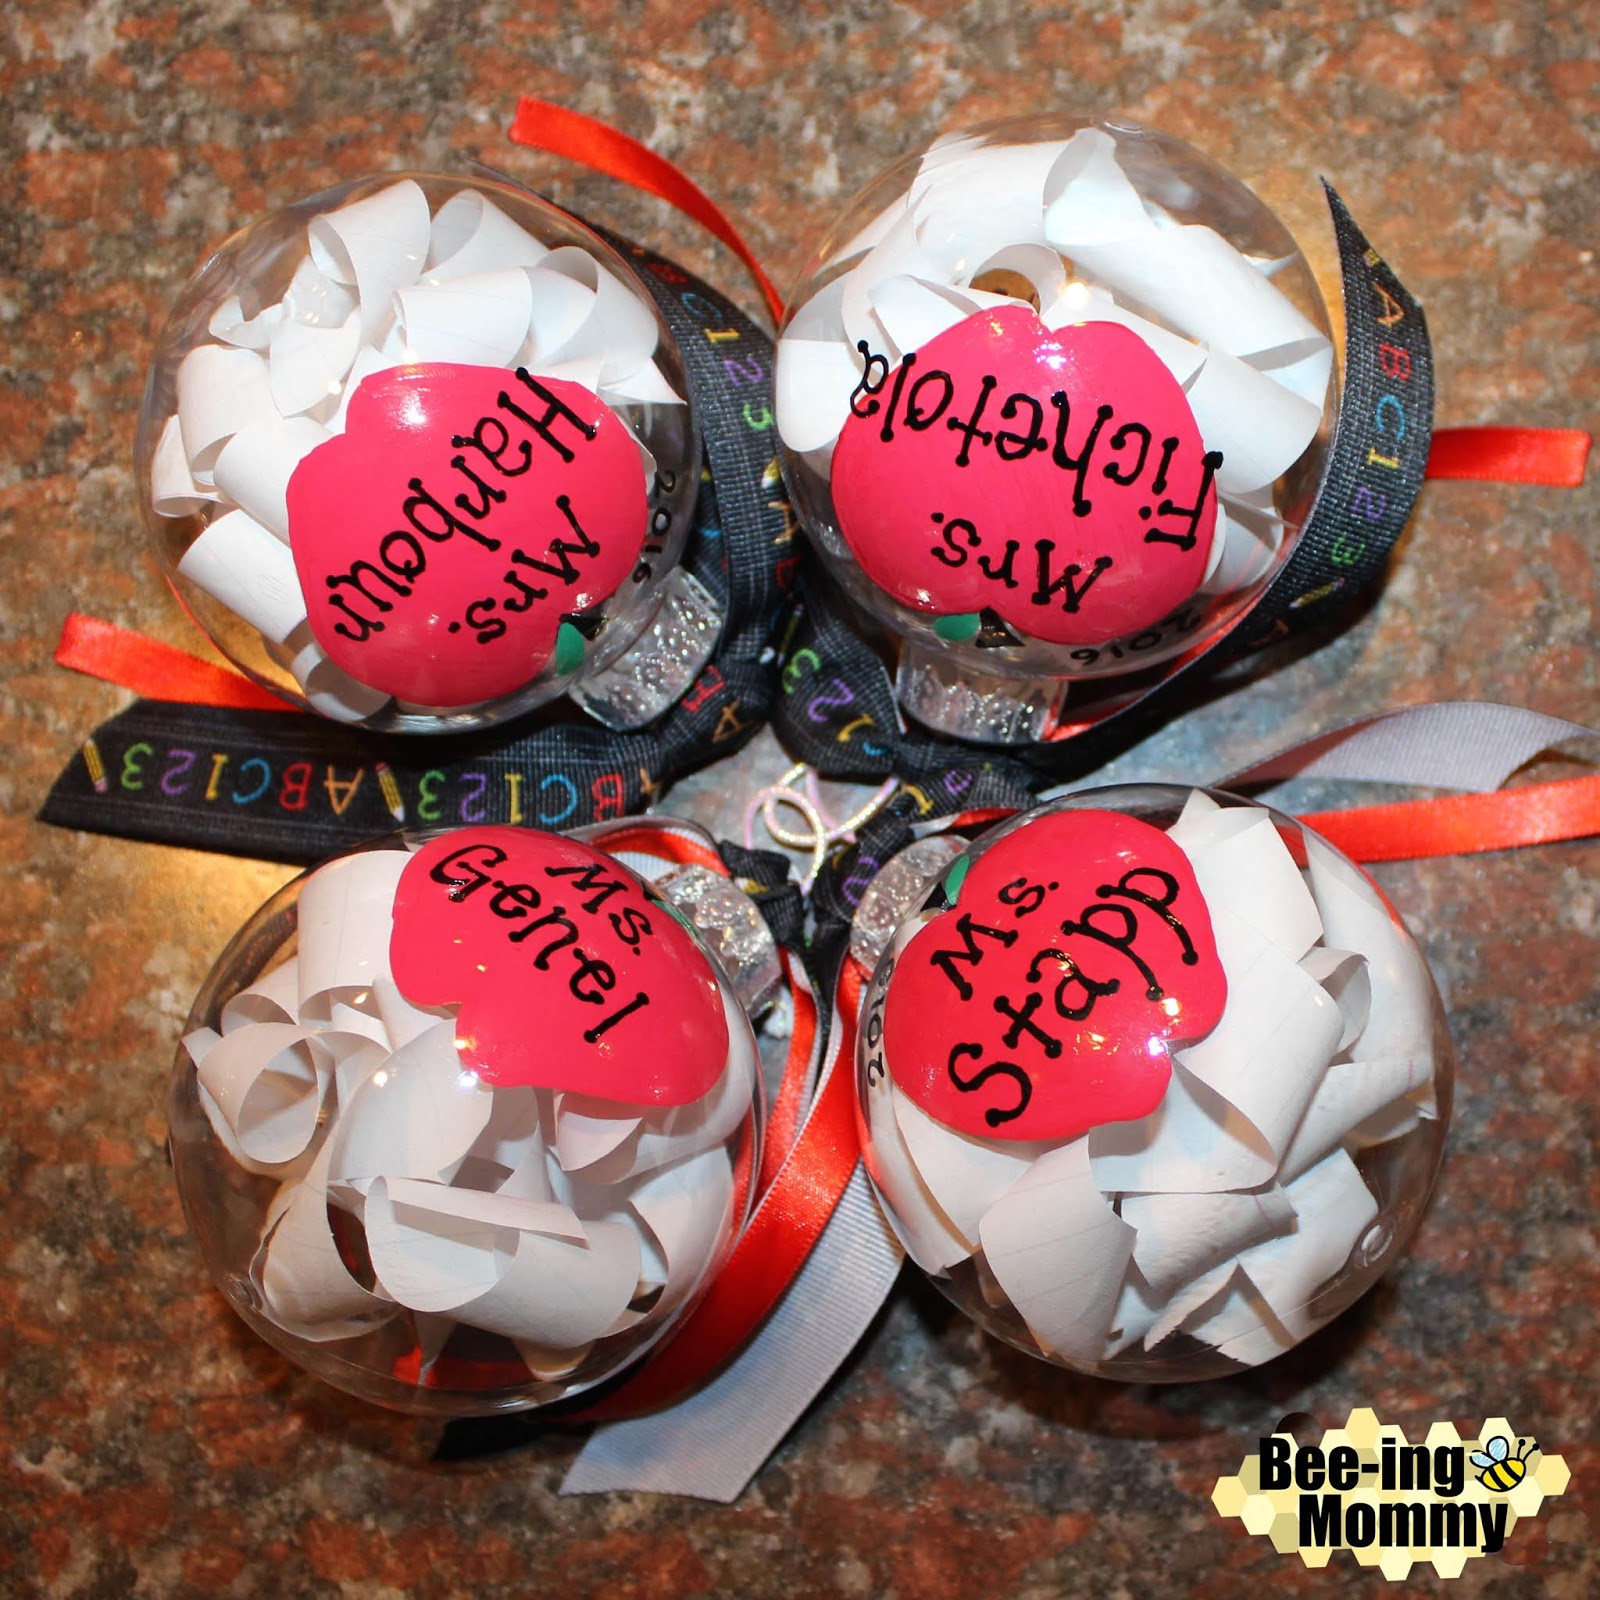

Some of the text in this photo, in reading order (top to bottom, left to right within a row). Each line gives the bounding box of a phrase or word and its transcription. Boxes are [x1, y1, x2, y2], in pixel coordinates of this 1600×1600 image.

[325, 366, 597, 642] Harbour
[850, 340, 1225, 552] Fichetola
[448, 495, 600, 644] Mrs.
[632, 470, 676, 583] 2016
[931, 512, 1113, 614] Mrs.
[1070, 606, 1203, 666] 2016
[430, 844, 650, 1044] Genel
[545, 863, 654, 956] Ms.
[930, 877, 1060, 1001] Ms.
[948, 867, 1199, 1128] Stapp
